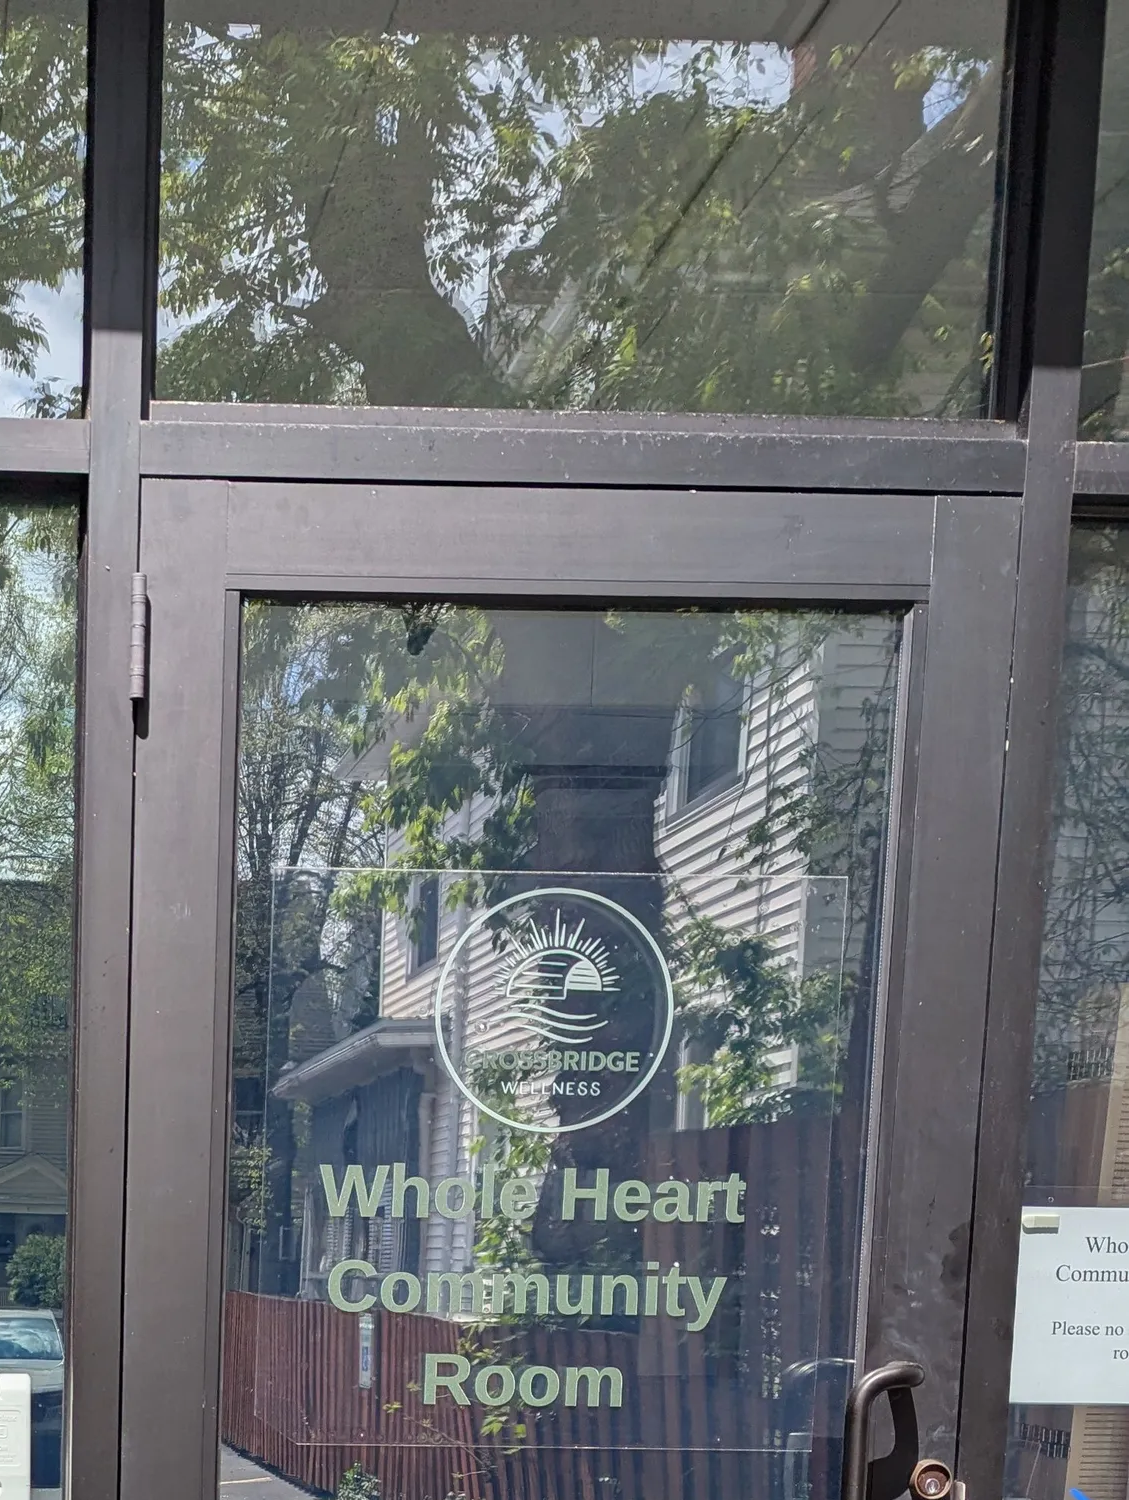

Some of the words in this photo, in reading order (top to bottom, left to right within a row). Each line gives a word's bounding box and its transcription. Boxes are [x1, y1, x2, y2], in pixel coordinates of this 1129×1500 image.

[464, 1049, 641, 1073] CROSSBRIDGE
[501, 1081, 601, 1096] WELLNESS
[320, 1162, 538, 1220] Whole
[562, 1168, 746, 1224] Heart
[1085, 1236, 1129, 1254] Who
[1056, 1264, 1129, 1282] Commu
[326, 1259, 727, 1333] Community
[1051, 1320, 1101, 1336] Please
[1105, 1325, 1124, 1336] no
[422, 1354, 624, 1408] Room
